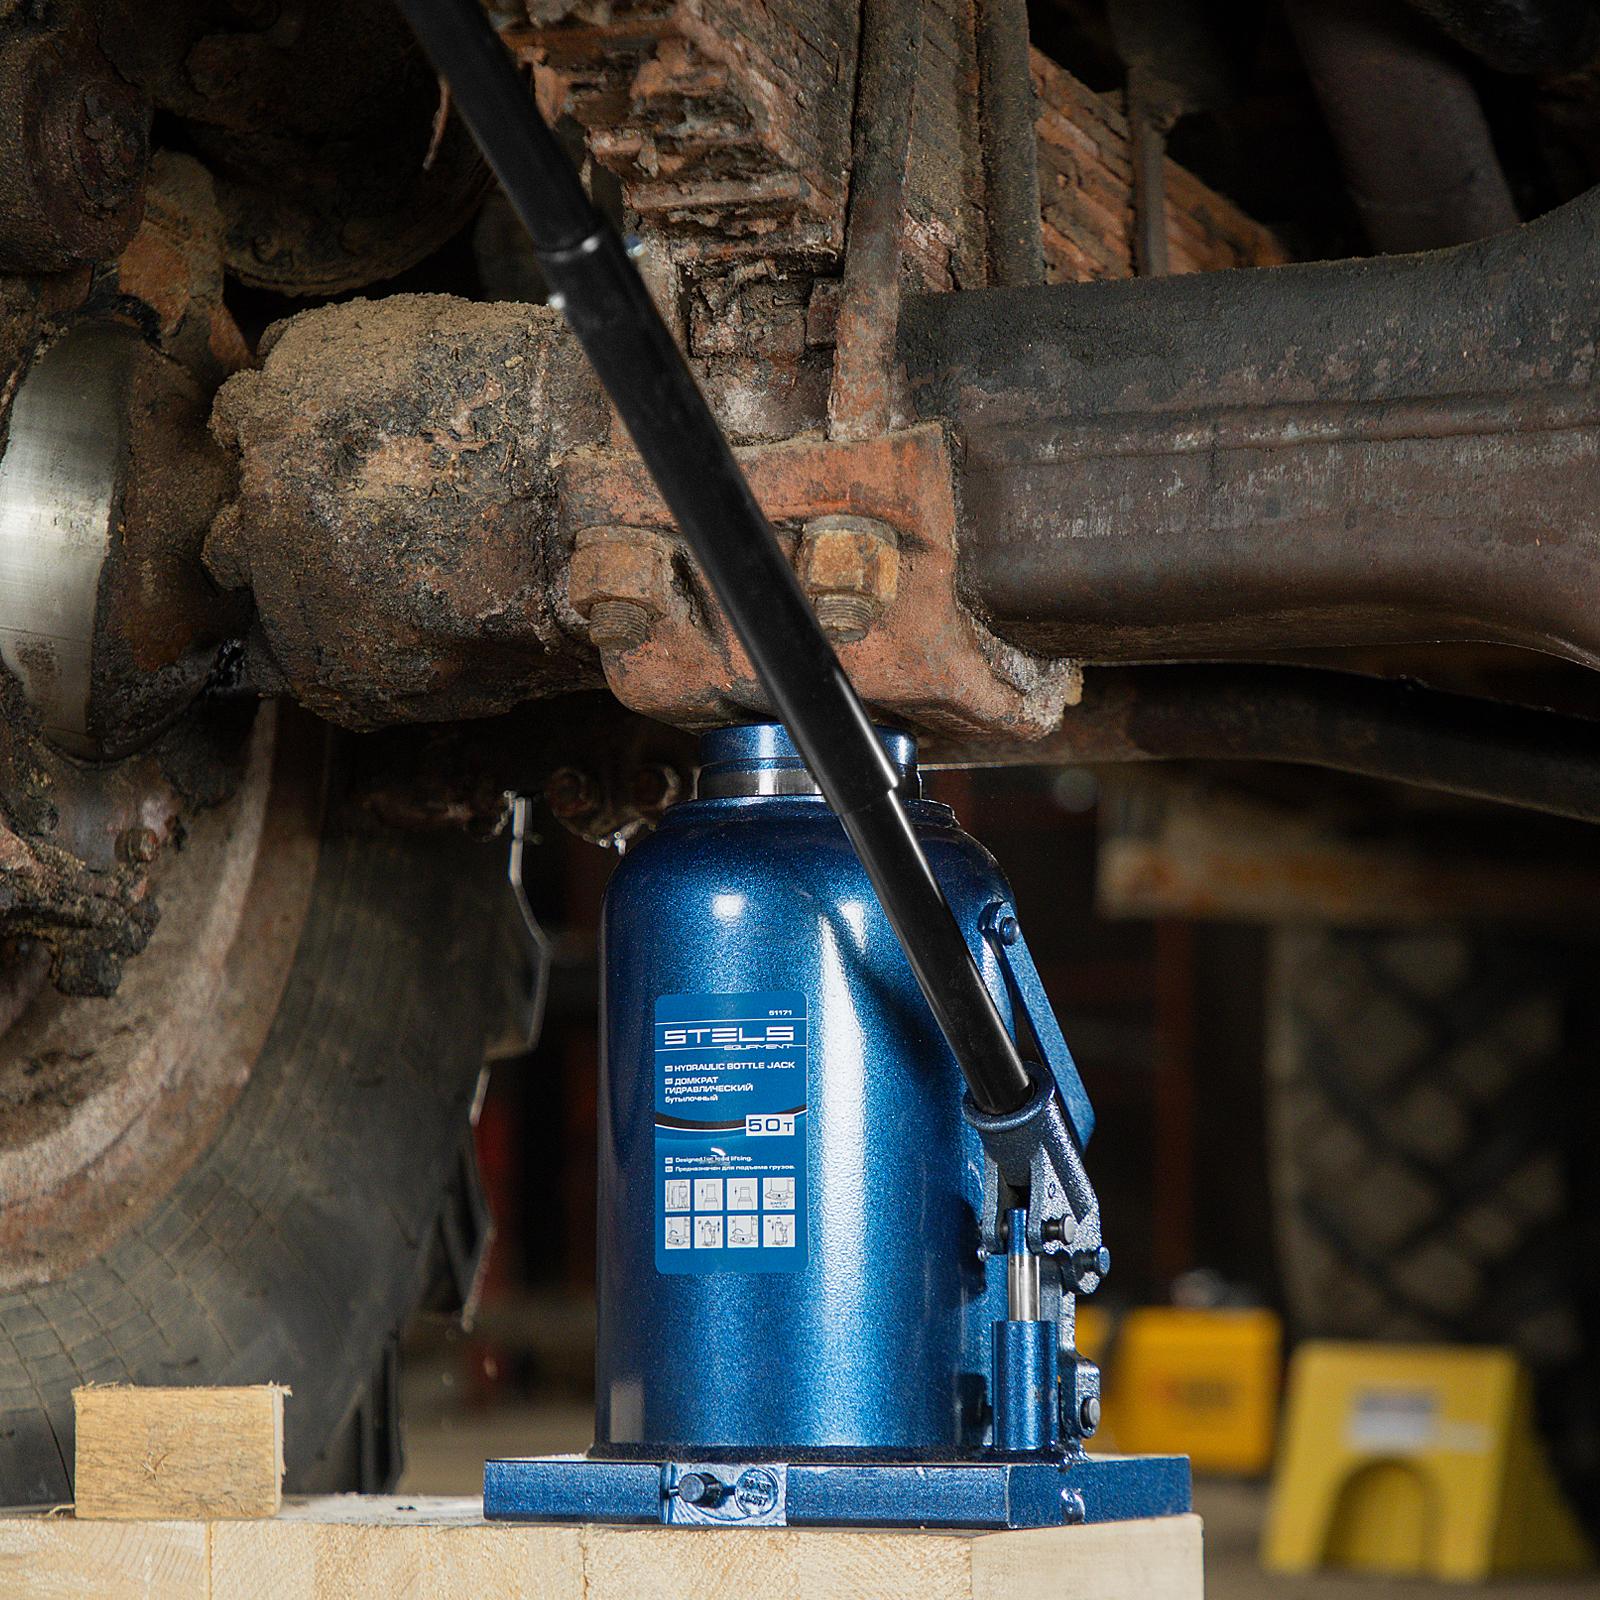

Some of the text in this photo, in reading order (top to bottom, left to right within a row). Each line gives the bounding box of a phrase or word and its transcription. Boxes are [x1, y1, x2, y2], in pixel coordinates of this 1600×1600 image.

[664, 1026, 794, 1045] STELS
[724, 1043, 792, 1051] EQUIPMENT
[674, 1063, 725, 1072] HYDRAULIC
[727, 1062, 765, 1070] BOTTLE
[767, 1061, 795, 1069] JACK
[674, 1076, 718, 1086] ДОМКРАТ
[665, 1083, 753, 1095] ГИДРАВЛИЧЕСКИЙ
[665, 1094, 718, 1104] бутылочный
